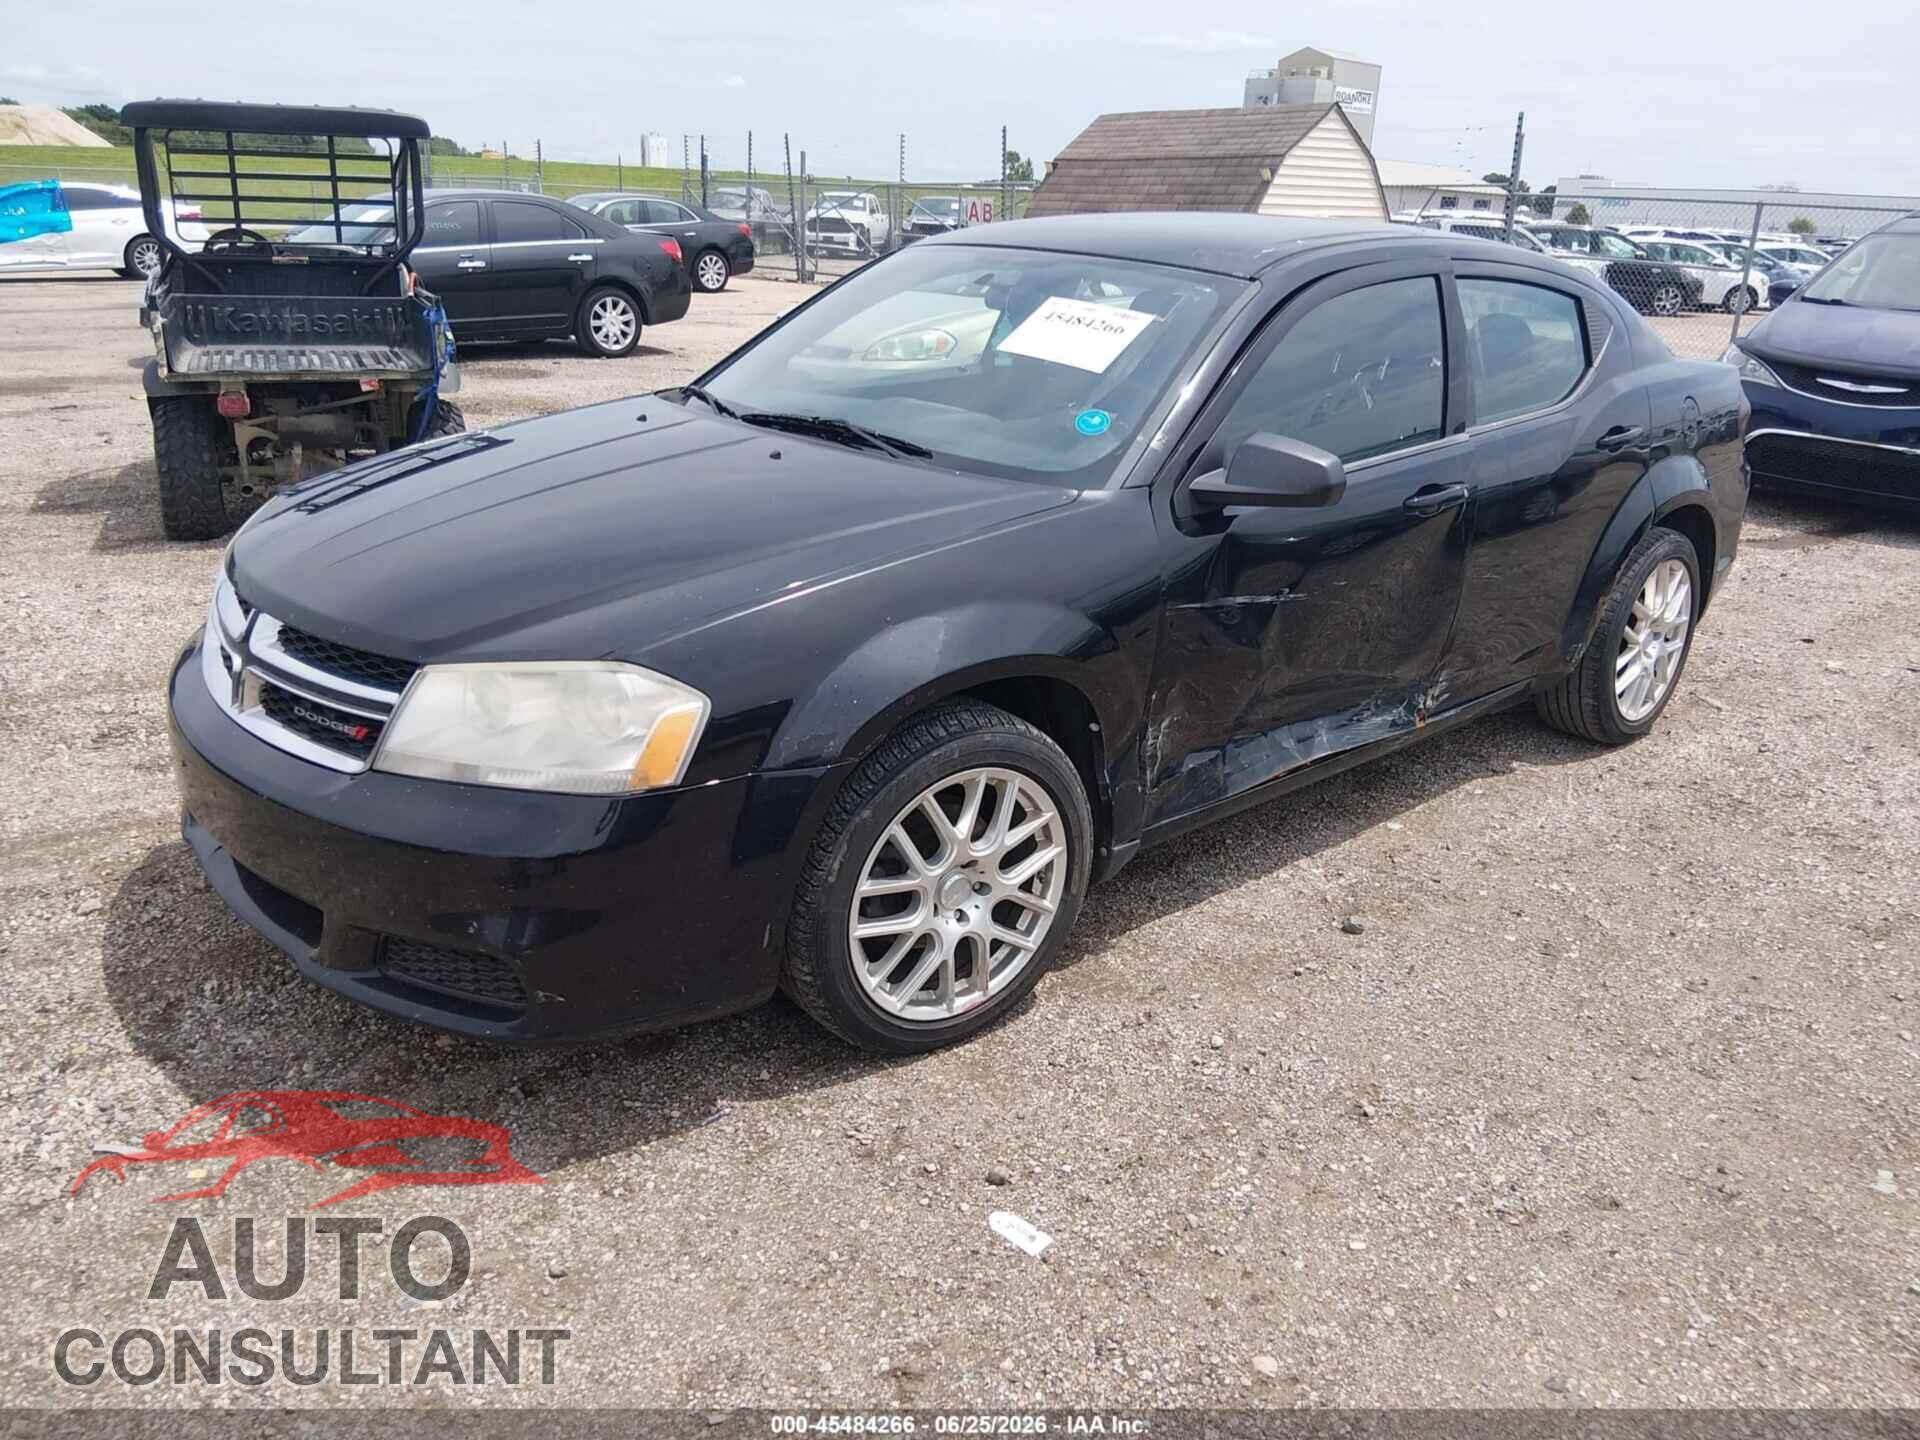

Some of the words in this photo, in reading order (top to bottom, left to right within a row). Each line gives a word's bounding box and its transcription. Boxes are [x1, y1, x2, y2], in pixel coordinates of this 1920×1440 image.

[1335, 90, 1372, 104] ROANOKE
[211, 306, 382, 335] Kawasaki
[293, 705, 355, 737] DODGE
